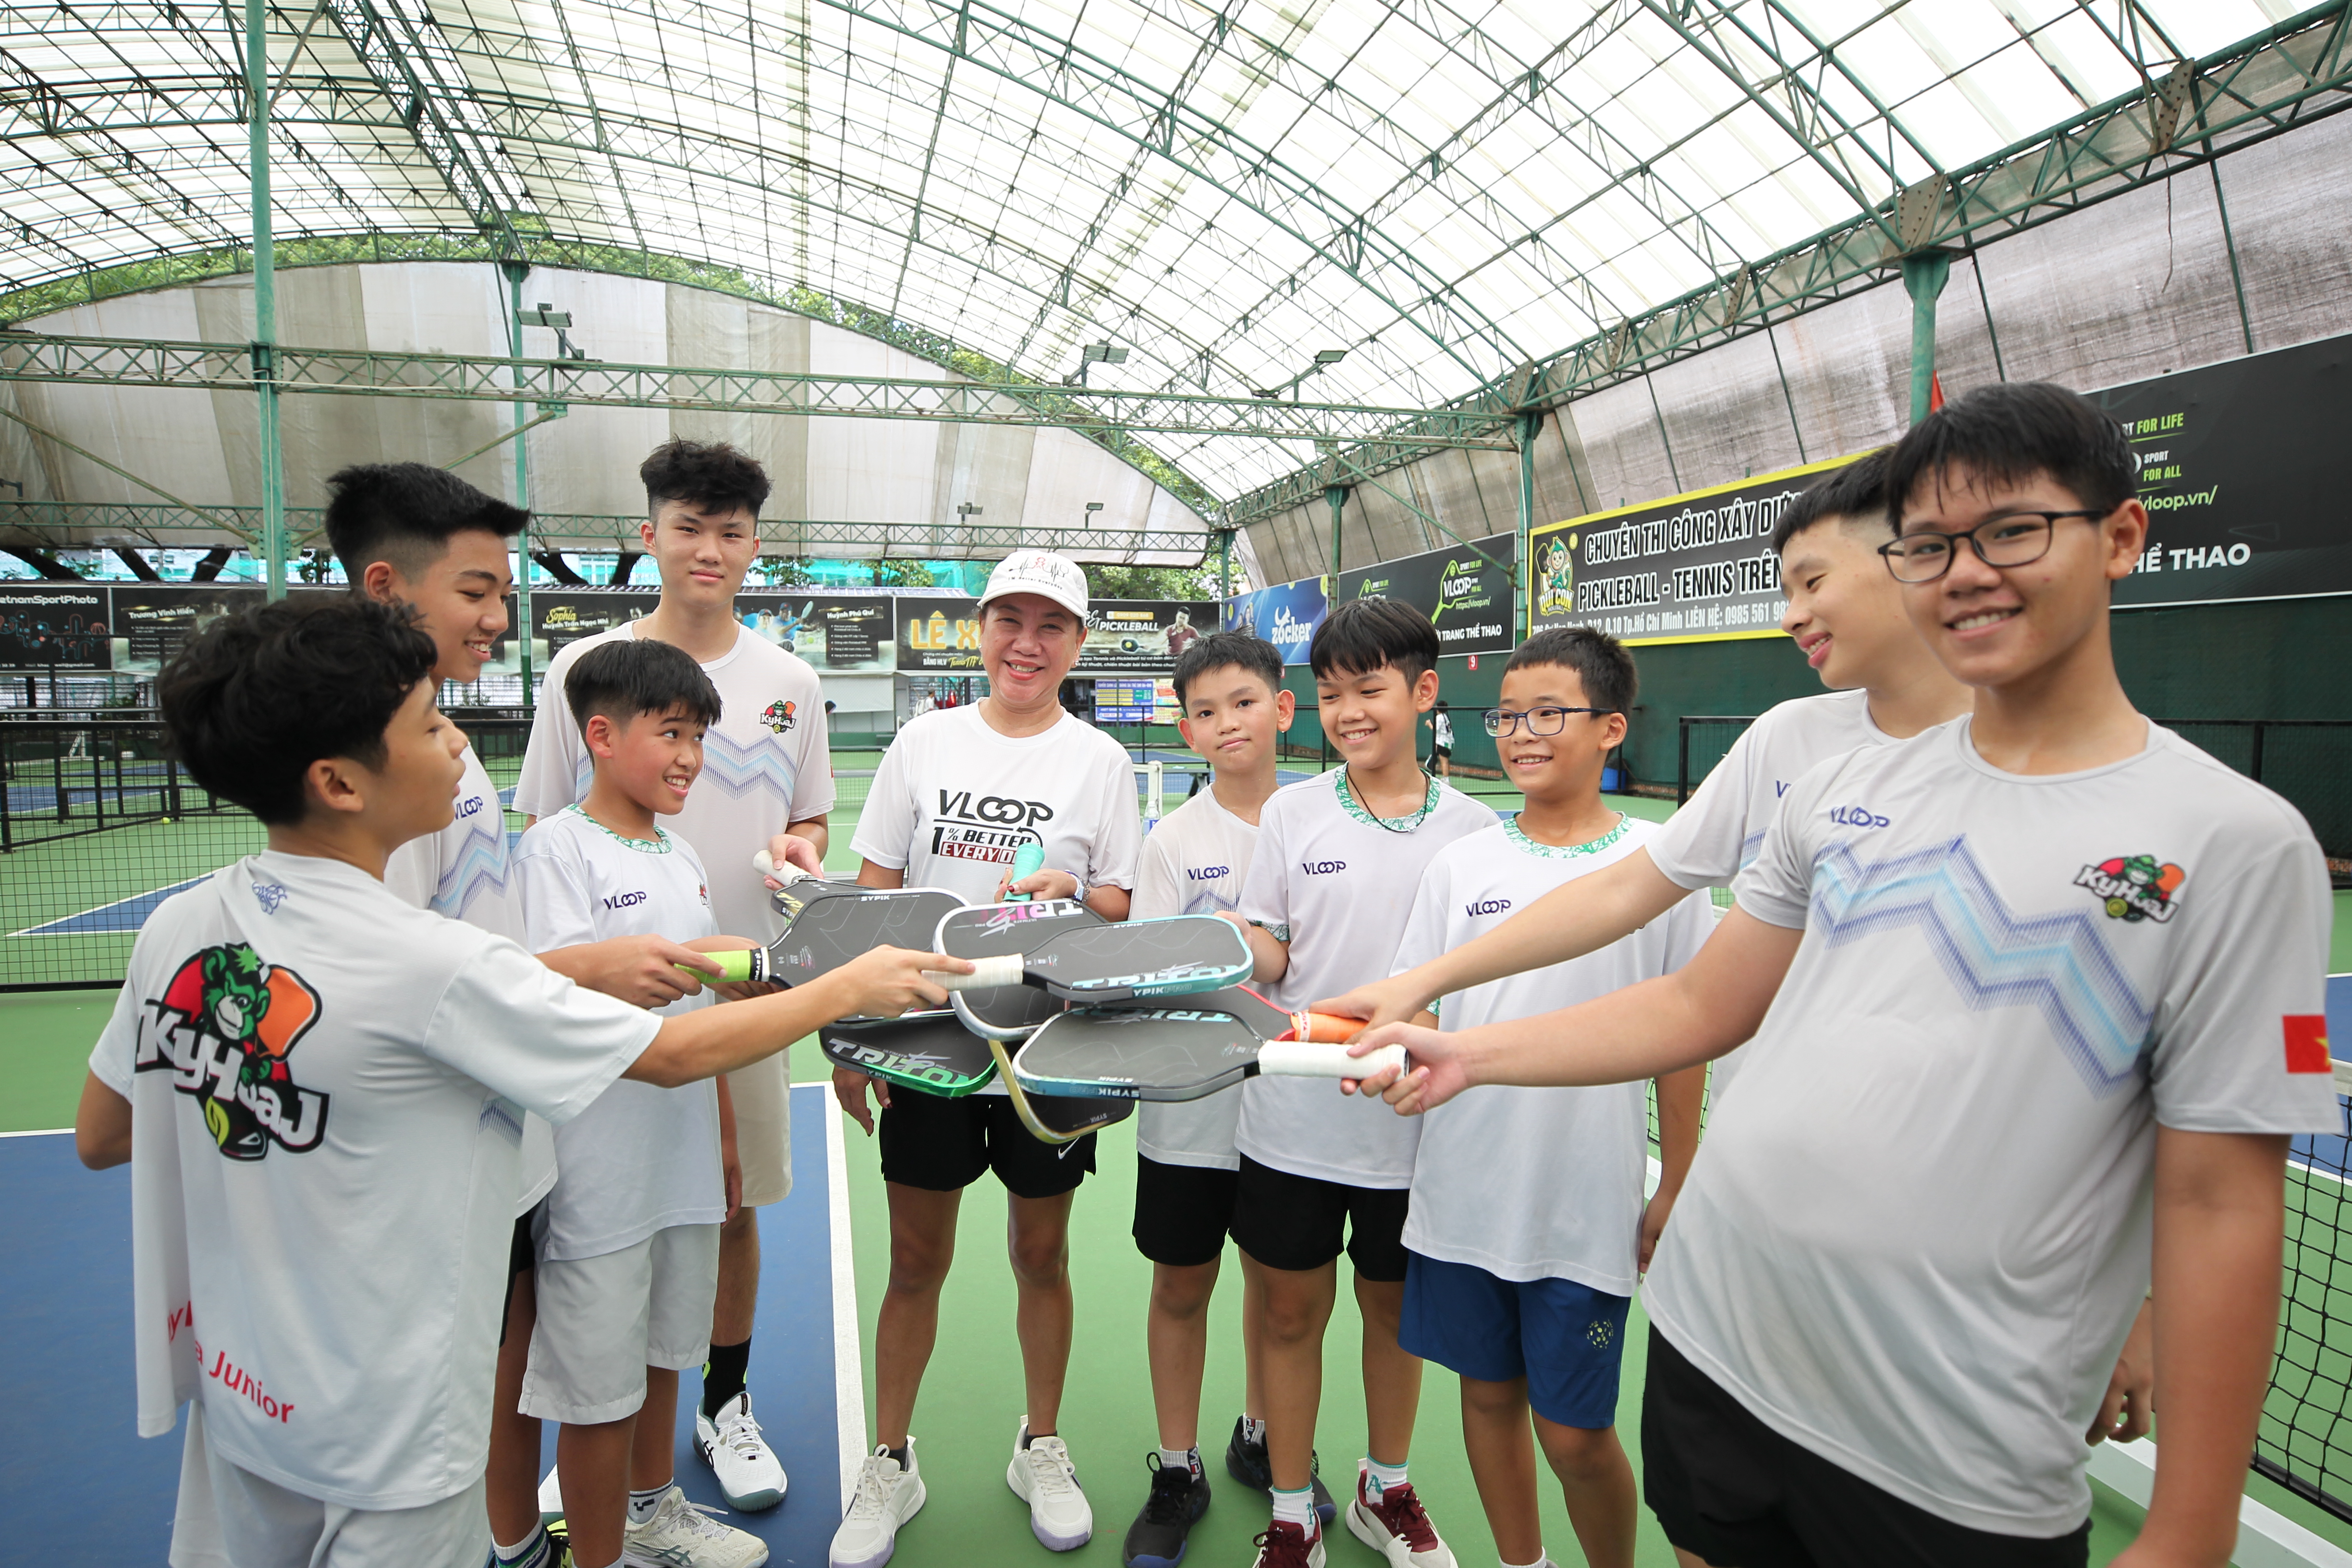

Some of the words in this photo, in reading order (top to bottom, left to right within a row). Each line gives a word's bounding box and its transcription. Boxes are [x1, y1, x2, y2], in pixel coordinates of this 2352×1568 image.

[2136, 417, 2157, 434] FOR
[2161, 412, 2184, 430] LIFE
[2144, 450, 2169, 464] SPORT
[2143, 469, 2162, 482] FOR
[2164, 465, 2181, 479] ALL
[1585, 521, 1640, 565] CHUYÊN
[1642, 519, 1667, 556] THI
[1670, 508, 1716, 551] CÔNG
[1718, 497, 1756, 543] XÂY
[1460, 562, 1470, 571] SPORT
[2128, 542, 2162, 574] HỂ
[2169, 543, 2251, 571] THAO
[1444, 576, 1471, 597] VLOOP
[1578, 572, 1660, 612] PICKLEBALL
[1673, 560, 1735, 602] TENNIS
[546, 607, 576, 624] Sophia
[1647, 613, 1660, 631] Chí
[1662, 611, 1683, 630] Minh
[1686, 605, 1705, 628] LIÊN
[1708, 603, 1723, 630] HỆ:
[1725, 604, 1749, 625] 0985
[1752, 602, 1769, 623] 561
[911, 610, 946, 649] LÊ
[956, 620, 980, 649] X
[1099, 622, 1159, 631] PICKLEBALL
[1272, 616, 1311, 644] zocker
[1442, 628, 1465, 641] TRANG
[1466, 622, 1481, 638] THỂ
[1481, 624, 1503, 637] THAO
[1471, 656, 1476, 668] 9
[940, 789, 1054, 827] VLOOP
[1188, 866, 1230, 881] VLOOP
[1302, 860, 1346, 876] VLOOP
[602, 891, 647, 910] VLOOP
[1466, 899, 1511, 917] VLOOP
[782, 906, 794, 918] SYP
[1133, 986, 1164, 997] YPIK
[867, 1069, 893, 1081] YPIK
[1098, 1087, 1140, 1098] SYPIK
[1090, 1112, 1107, 1124] SYPIK
[208, 1350, 294, 1423] Junior
